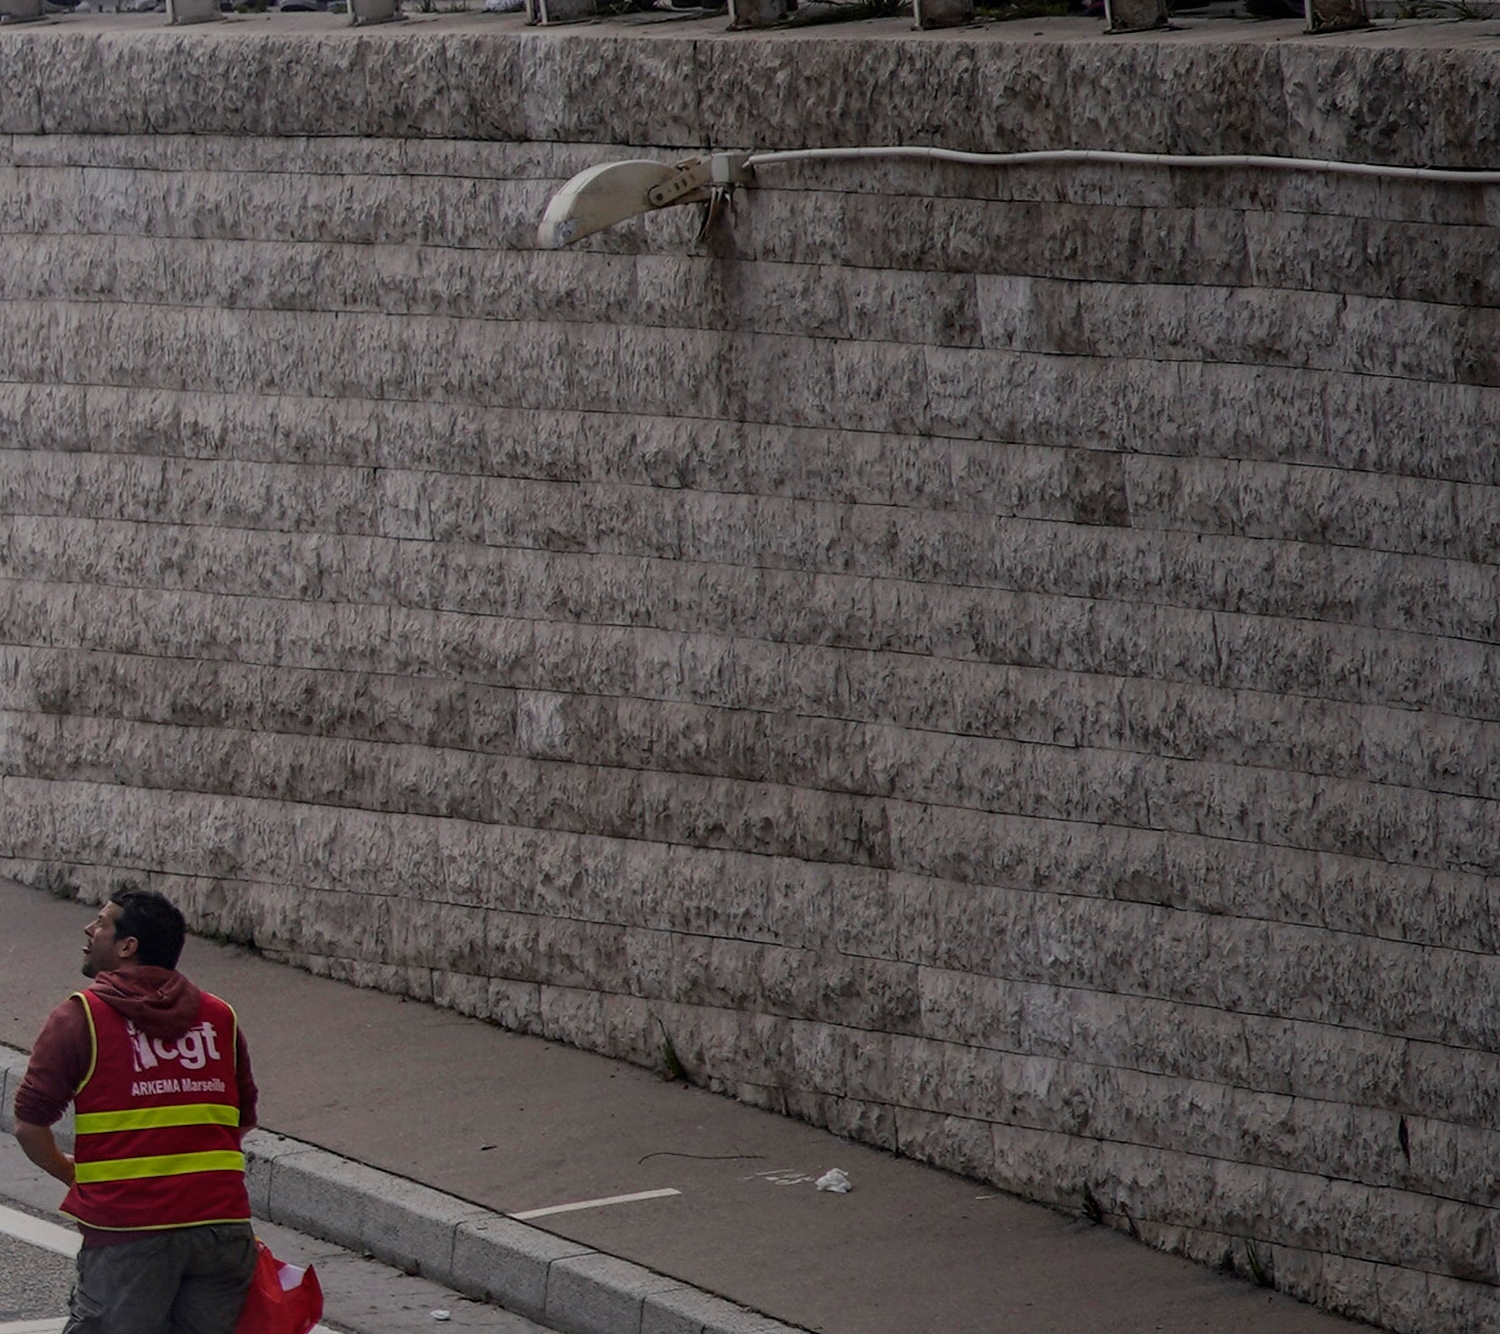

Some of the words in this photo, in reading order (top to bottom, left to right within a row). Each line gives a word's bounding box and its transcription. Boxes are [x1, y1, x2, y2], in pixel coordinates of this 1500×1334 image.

[153, 1021, 221, 1070] cgt
[131, 1077, 182, 1096] ARKEMA
[182, 1077, 226, 1093] Marseille
